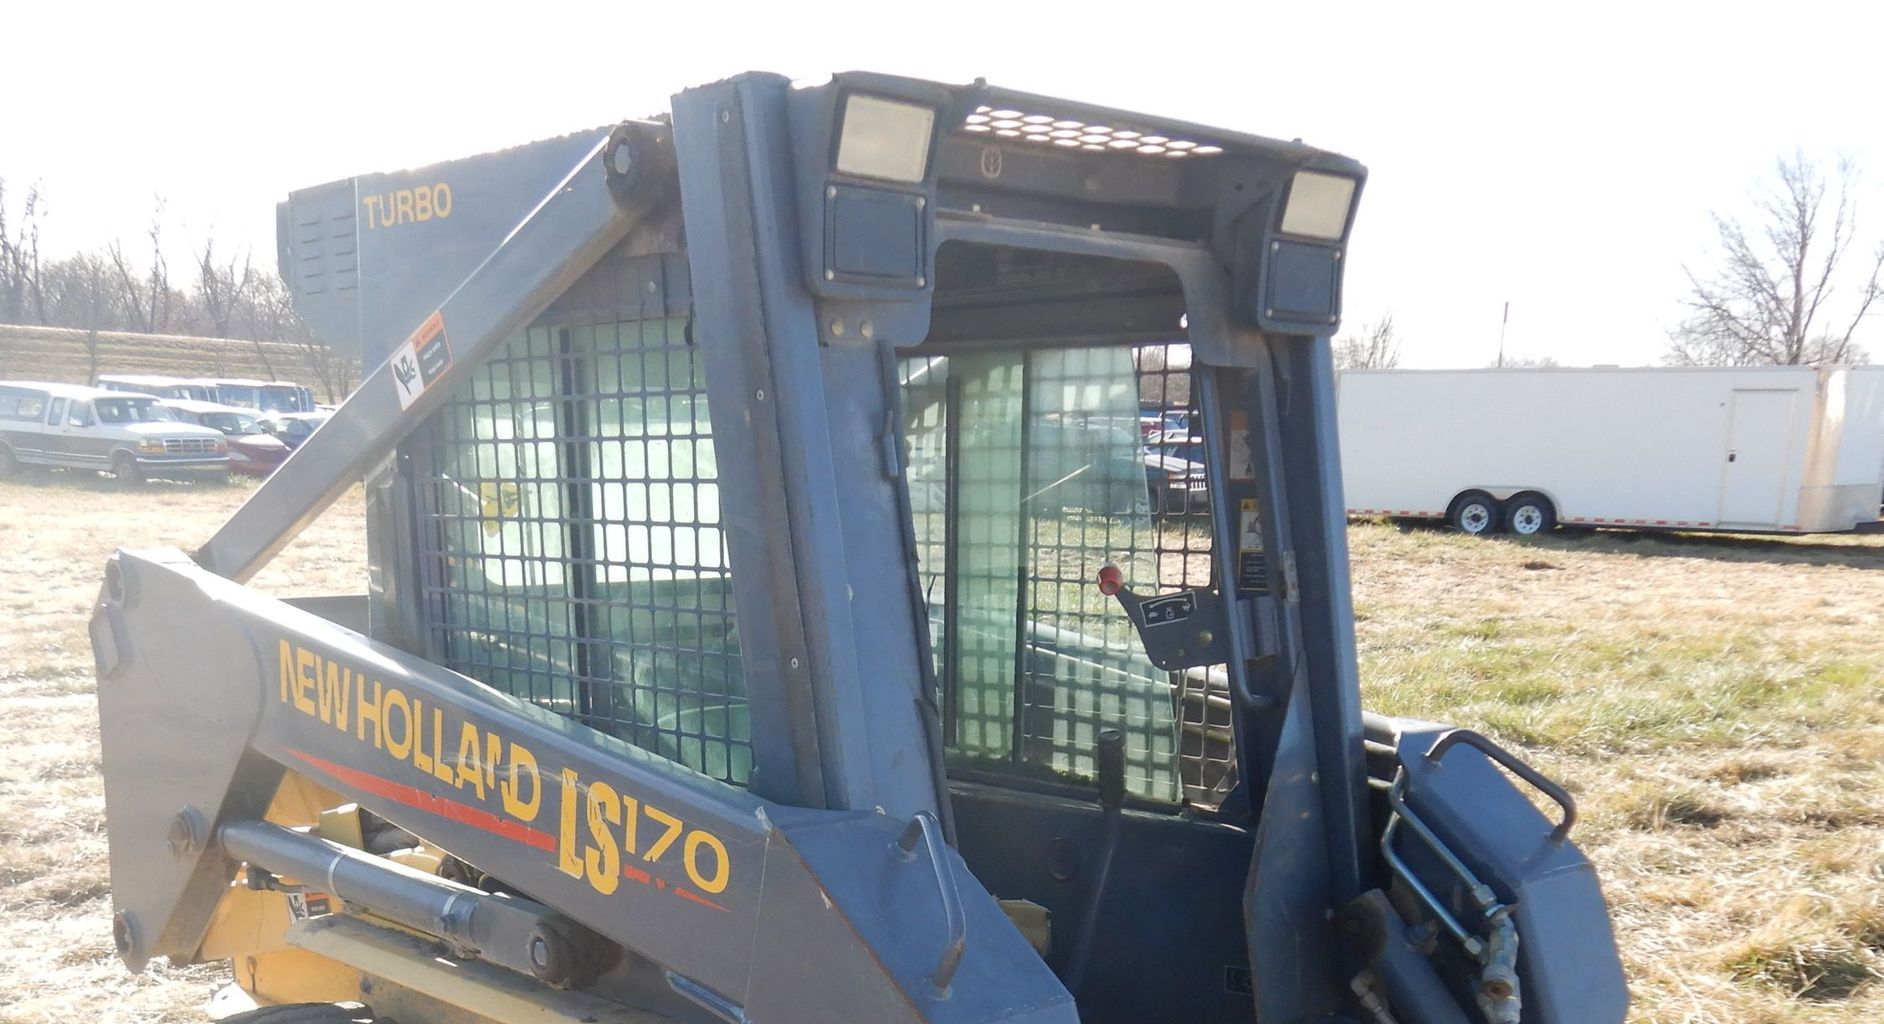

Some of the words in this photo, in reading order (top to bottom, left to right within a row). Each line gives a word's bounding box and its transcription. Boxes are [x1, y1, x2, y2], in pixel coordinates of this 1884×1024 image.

[363, 182, 453, 229] TURBO
[278, 638, 352, 733] NEW
[356, 673, 542, 823] HOLLAND
